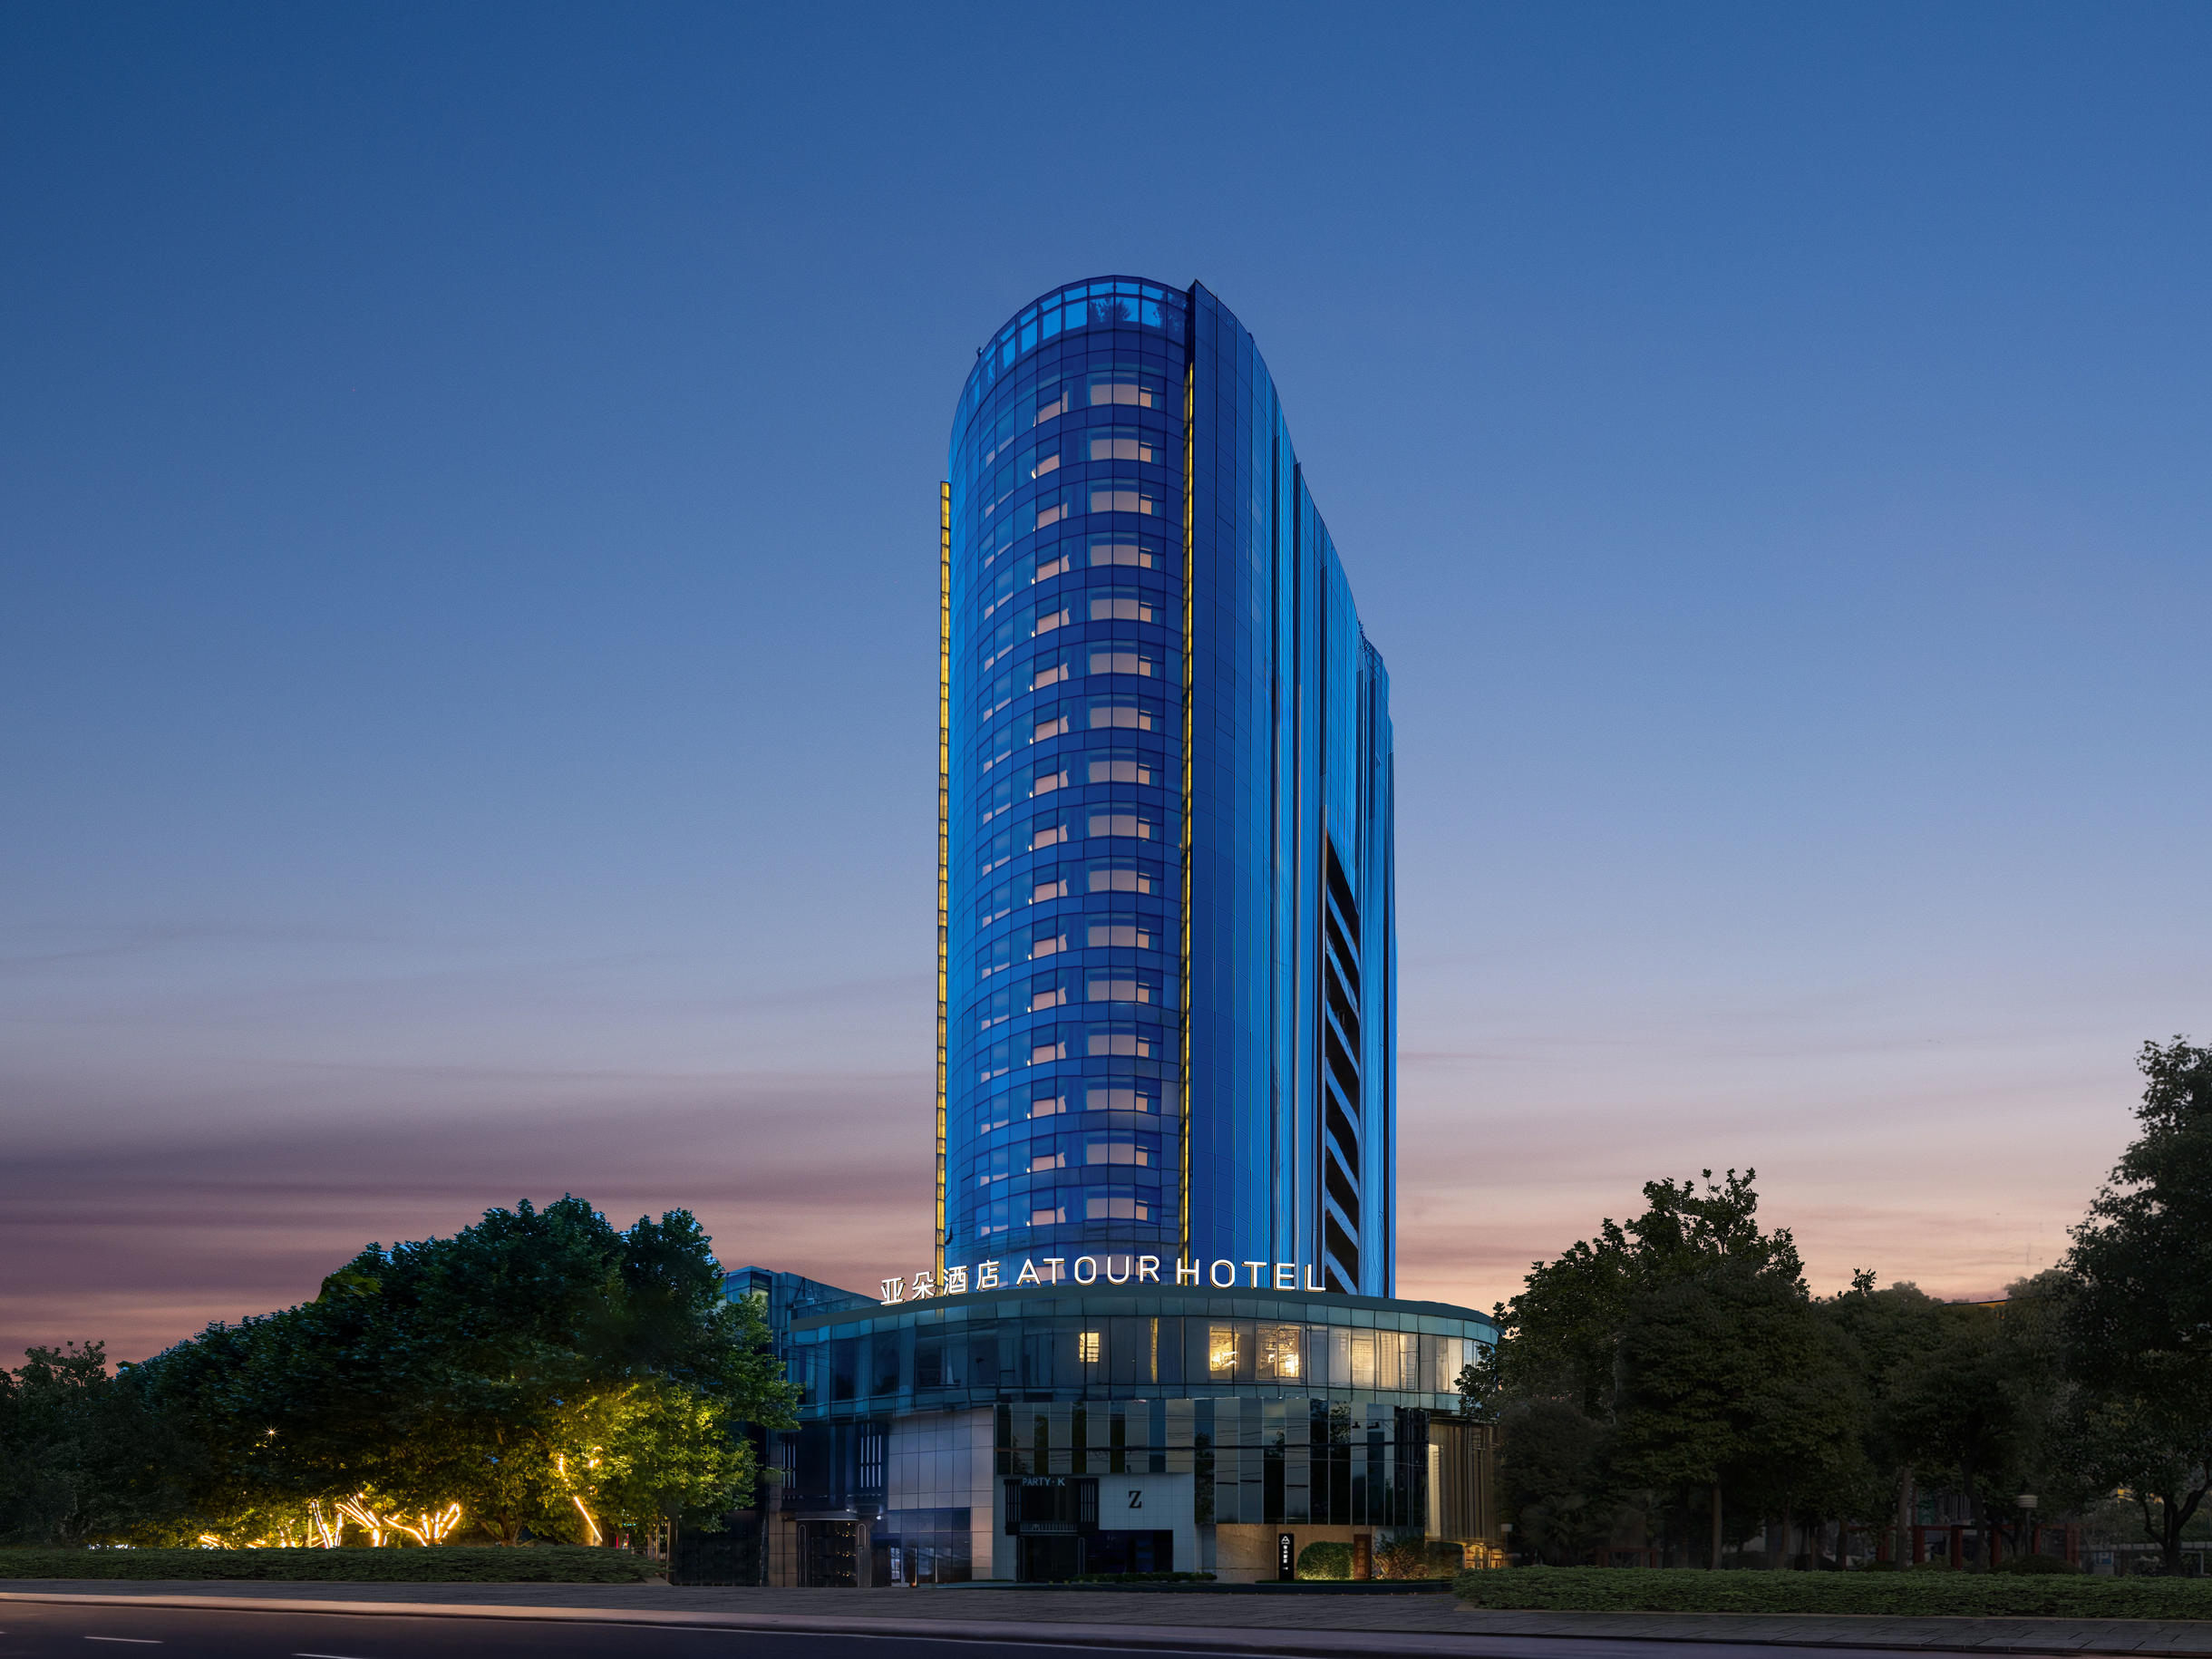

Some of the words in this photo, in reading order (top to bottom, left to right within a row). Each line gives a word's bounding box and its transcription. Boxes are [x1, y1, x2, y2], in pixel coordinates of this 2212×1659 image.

[880, 1259, 1000, 1305] 亚朵酒店
[1016, 1255, 1160, 1285] ATOUR
[1175, 1258, 1326, 1292] HOTEL
[1128, 1490, 1142, 1509] Z
